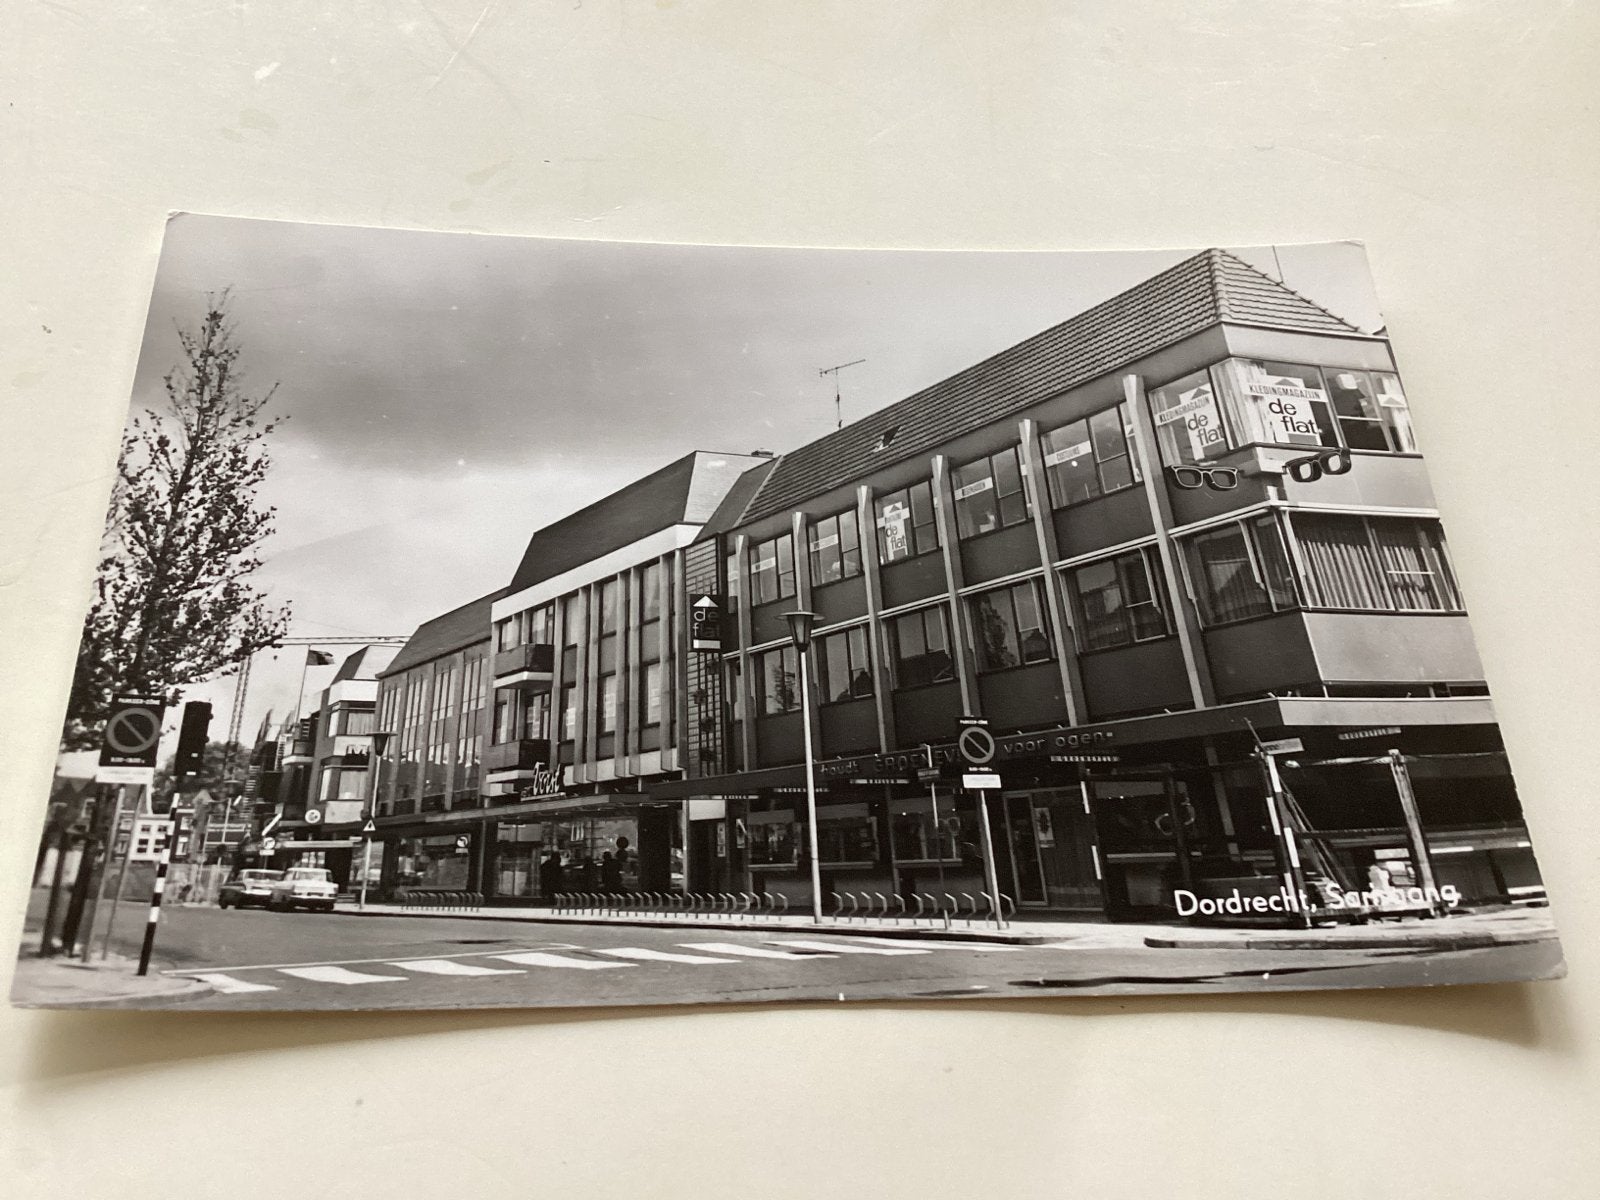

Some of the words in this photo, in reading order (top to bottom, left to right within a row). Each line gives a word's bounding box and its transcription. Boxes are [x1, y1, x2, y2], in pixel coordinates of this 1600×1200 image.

[1249, 384, 1321, 400] KLEDINGMAGAZIJN
[1268, 398, 1297, 416] de
[1187, 413, 1209, 431] de
[1280, 415, 1318, 435] flat
[1197, 424, 1224, 446] flat
[886, 524, 898, 538] de
[1003, 739, 1046, 754] voor
